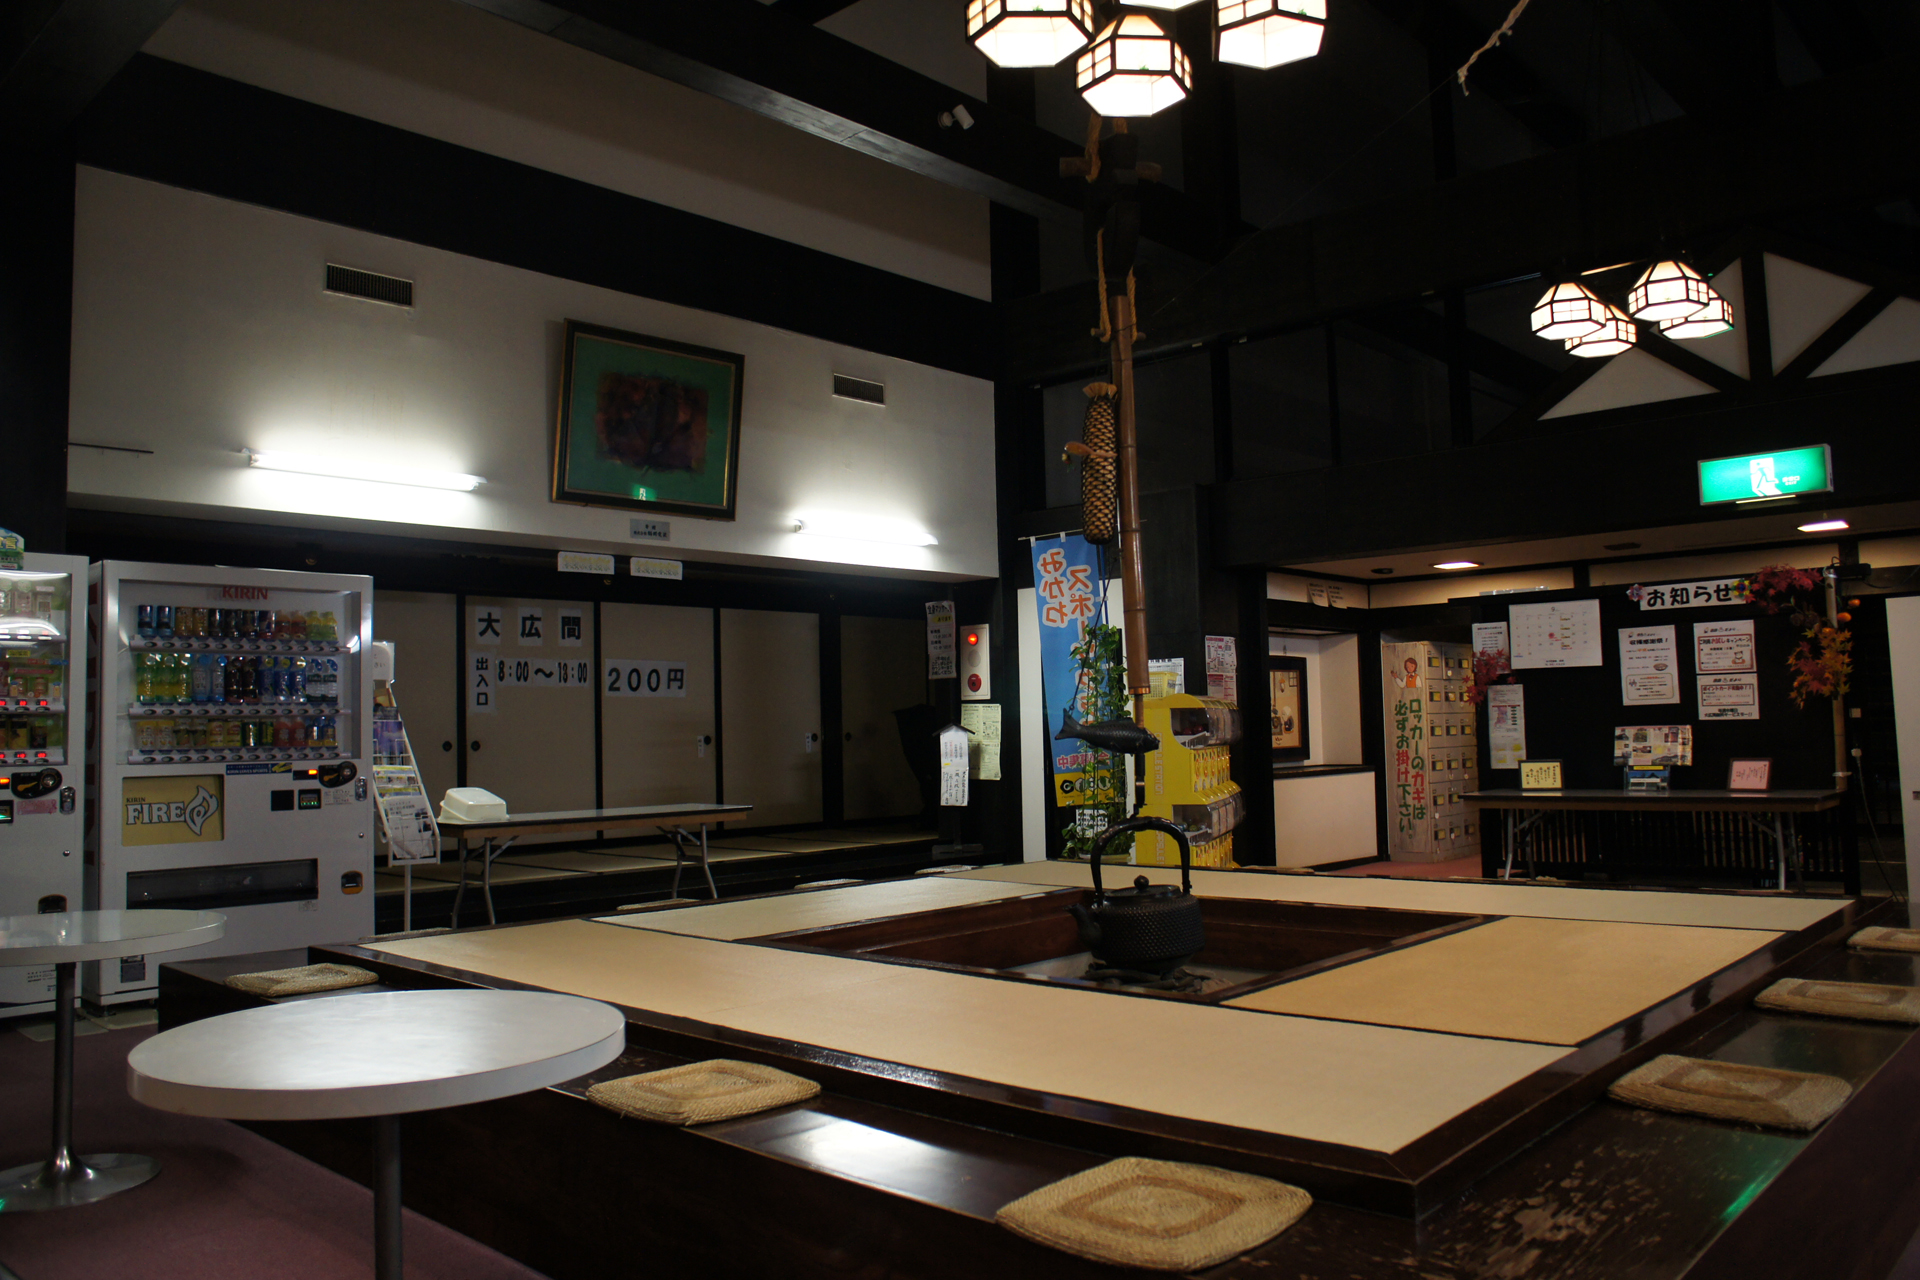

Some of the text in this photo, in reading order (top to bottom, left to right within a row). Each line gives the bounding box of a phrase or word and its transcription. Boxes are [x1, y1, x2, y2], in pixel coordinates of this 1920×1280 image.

[222, 586, 268, 600] KIRIN
[1646, 583, 1735, 608] お知らせ
[478, 612, 581, 640] 大広間
[476, 657, 489, 706] 出入口
[607, 667, 684, 692] 200円
[1394, 699, 1413, 840] 必ずお掛け下さい。
[1409, 698, 1426, 820] ロッカーのカギは
[126, 801, 186, 825] FIRE
[1156, 829, 1166, 861] APSULE
